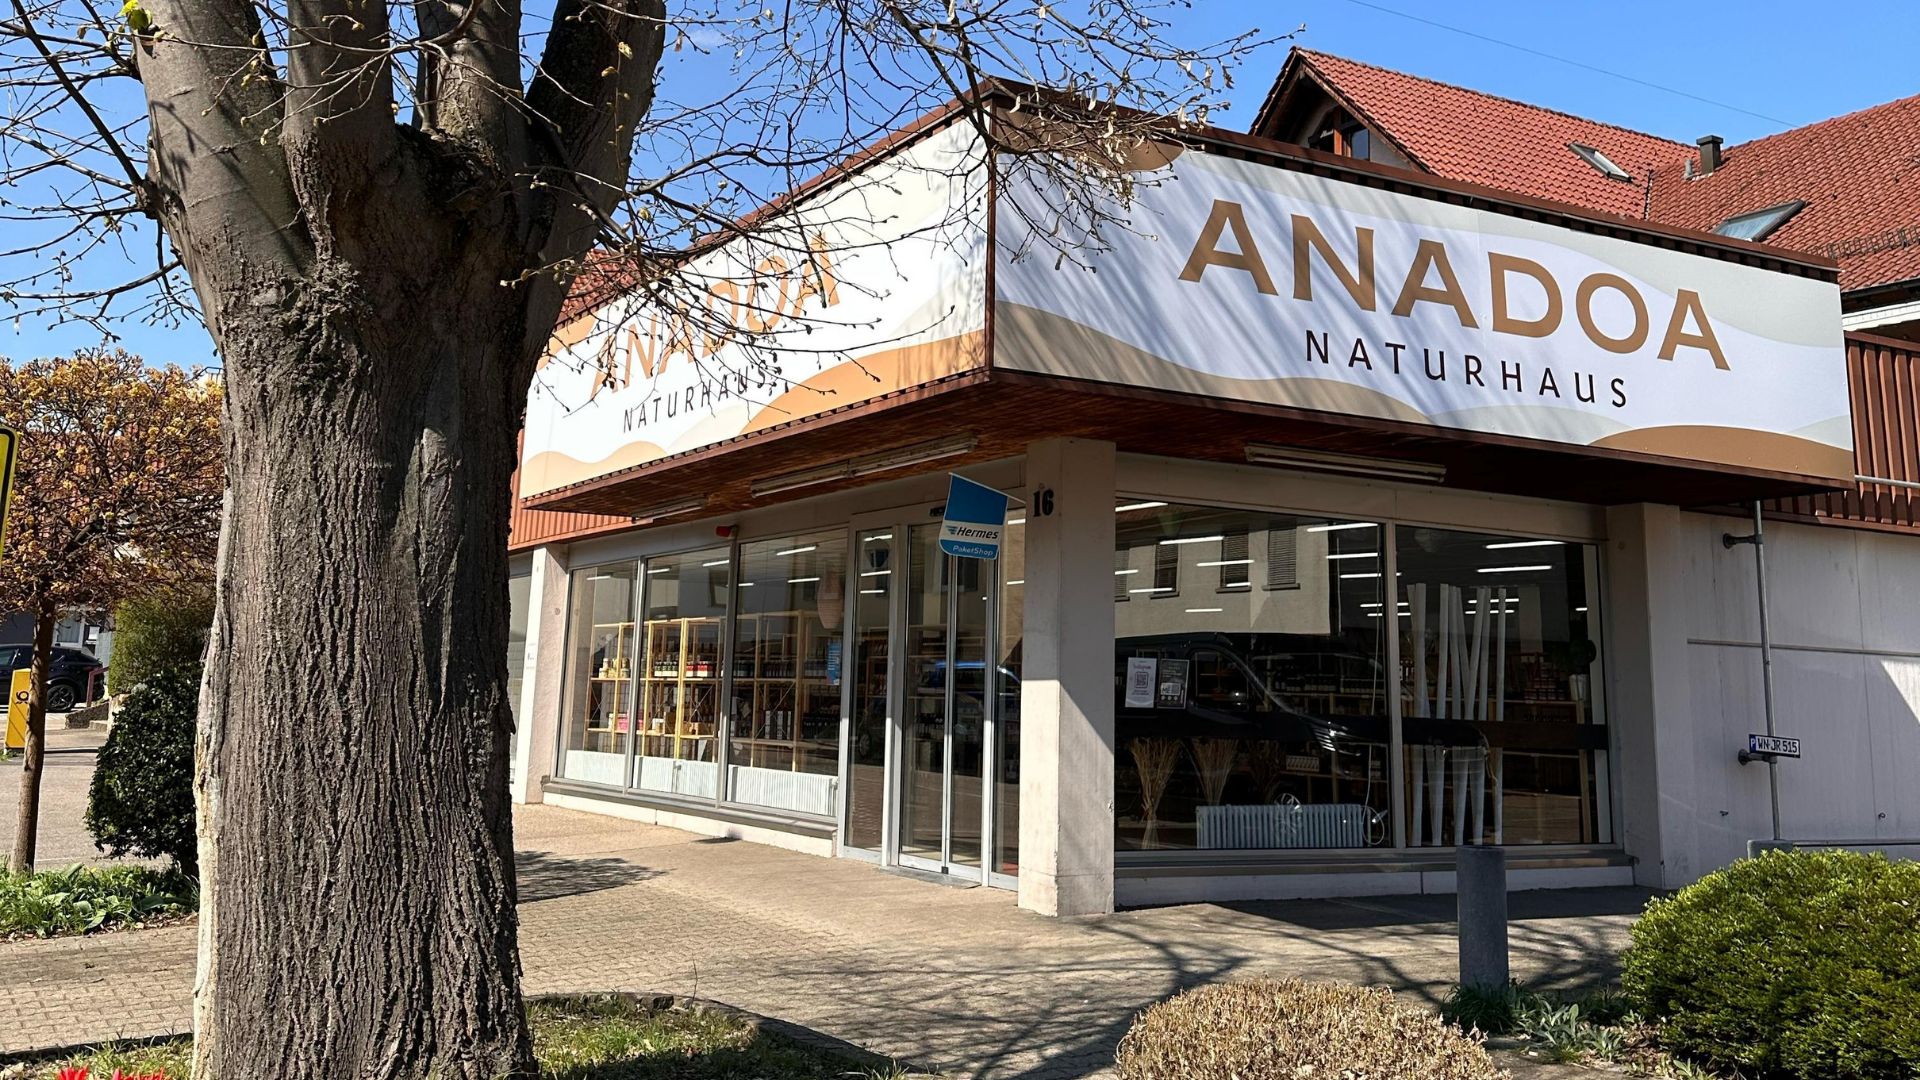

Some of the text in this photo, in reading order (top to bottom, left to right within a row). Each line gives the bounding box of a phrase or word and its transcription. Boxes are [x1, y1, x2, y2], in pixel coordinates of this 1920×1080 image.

[1179, 199, 1729, 371] ANADOA
[590, 232, 840, 400] ANADOA
[1307, 329, 1627, 409] NATURHAUS
[623, 365, 768, 433] NATURHAUS
[1033, 489, 1055, 517] 16
[953, 545, 994, 557] PaketShop
[957, 526, 999, 540] Hermes
[1783, 741, 1797, 753] 515
